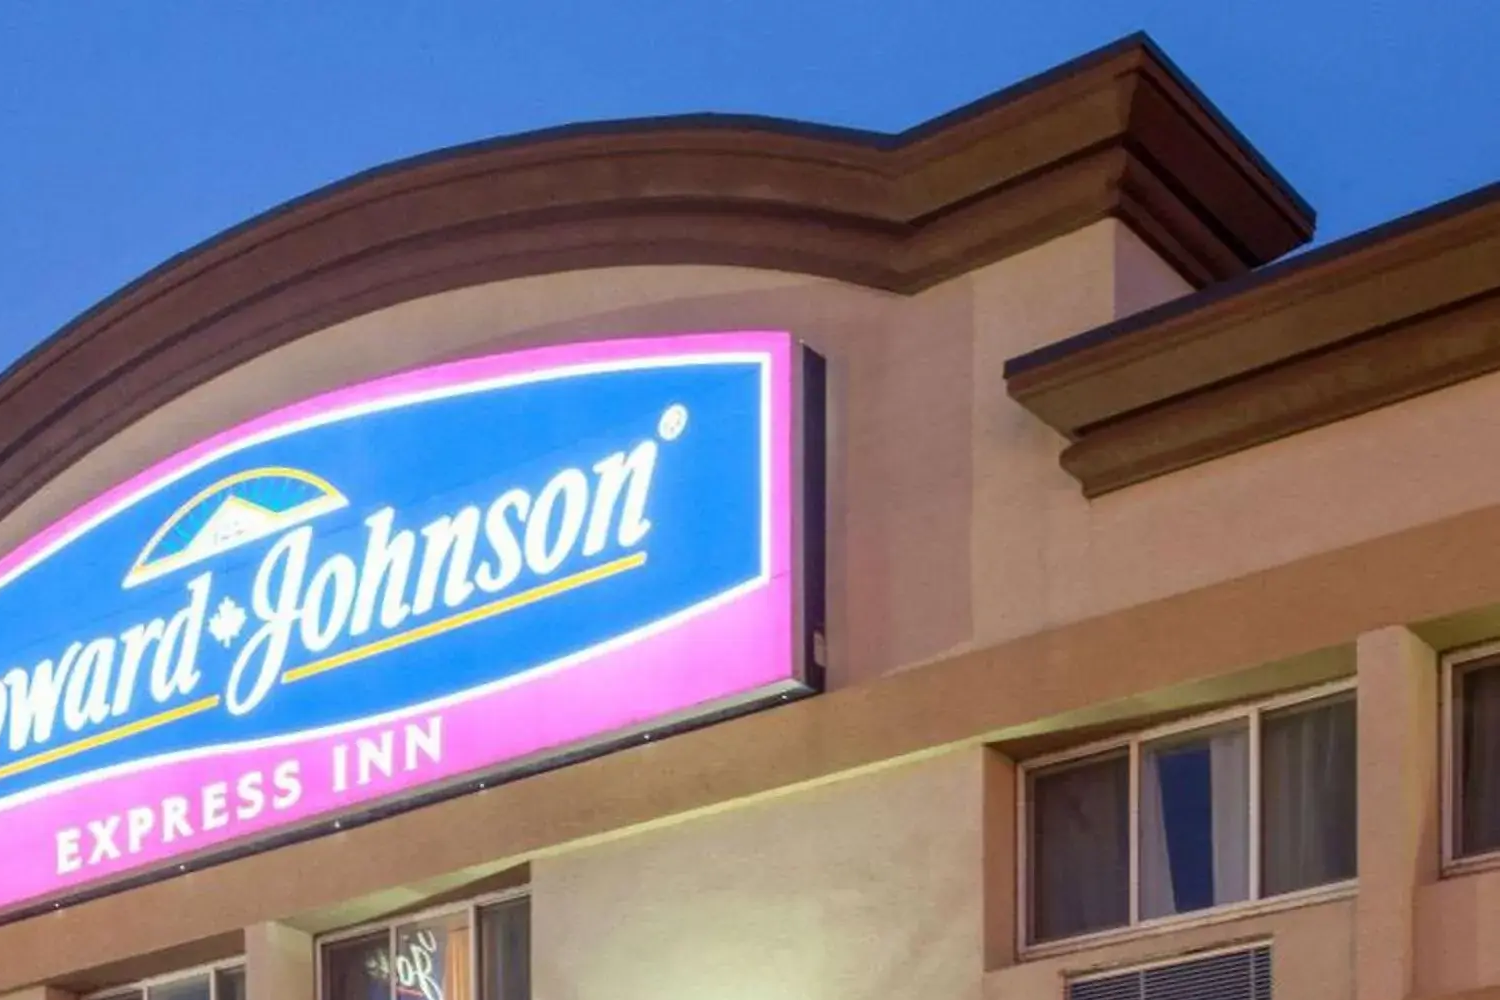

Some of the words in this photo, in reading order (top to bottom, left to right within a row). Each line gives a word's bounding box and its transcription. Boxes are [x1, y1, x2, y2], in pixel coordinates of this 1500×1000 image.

[226, 439, 658, 716] Johnson
[55, 759, 303, 875] EXPRESS
[332, 715, 443, 793] INN
